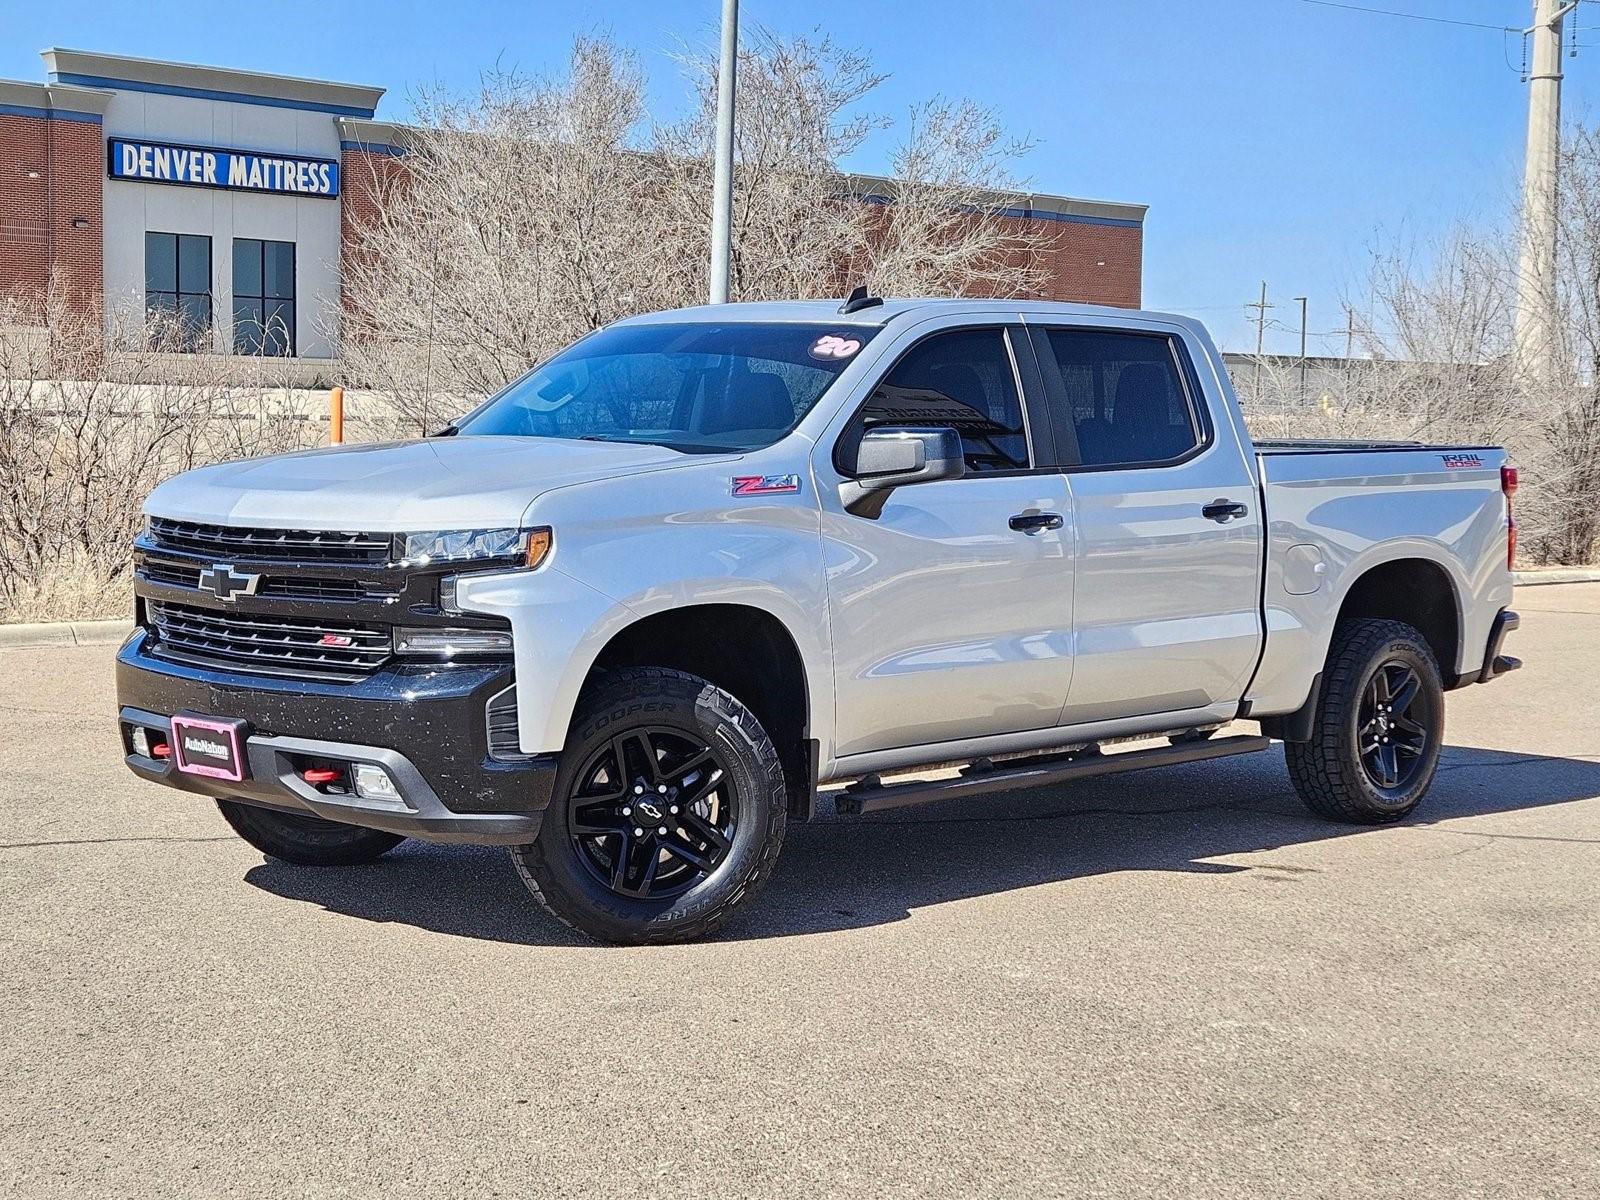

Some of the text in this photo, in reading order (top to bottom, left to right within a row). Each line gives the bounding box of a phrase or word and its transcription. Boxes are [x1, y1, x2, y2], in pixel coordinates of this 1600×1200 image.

[122, 144, 330, 193] DENVER MATTRESS
[813, 335, 860, 358] 20
[733, 475, 798, 495] Z71
[583, 702, 675, 740] COOPER
[184, 736, 229, 757] AutoNation
